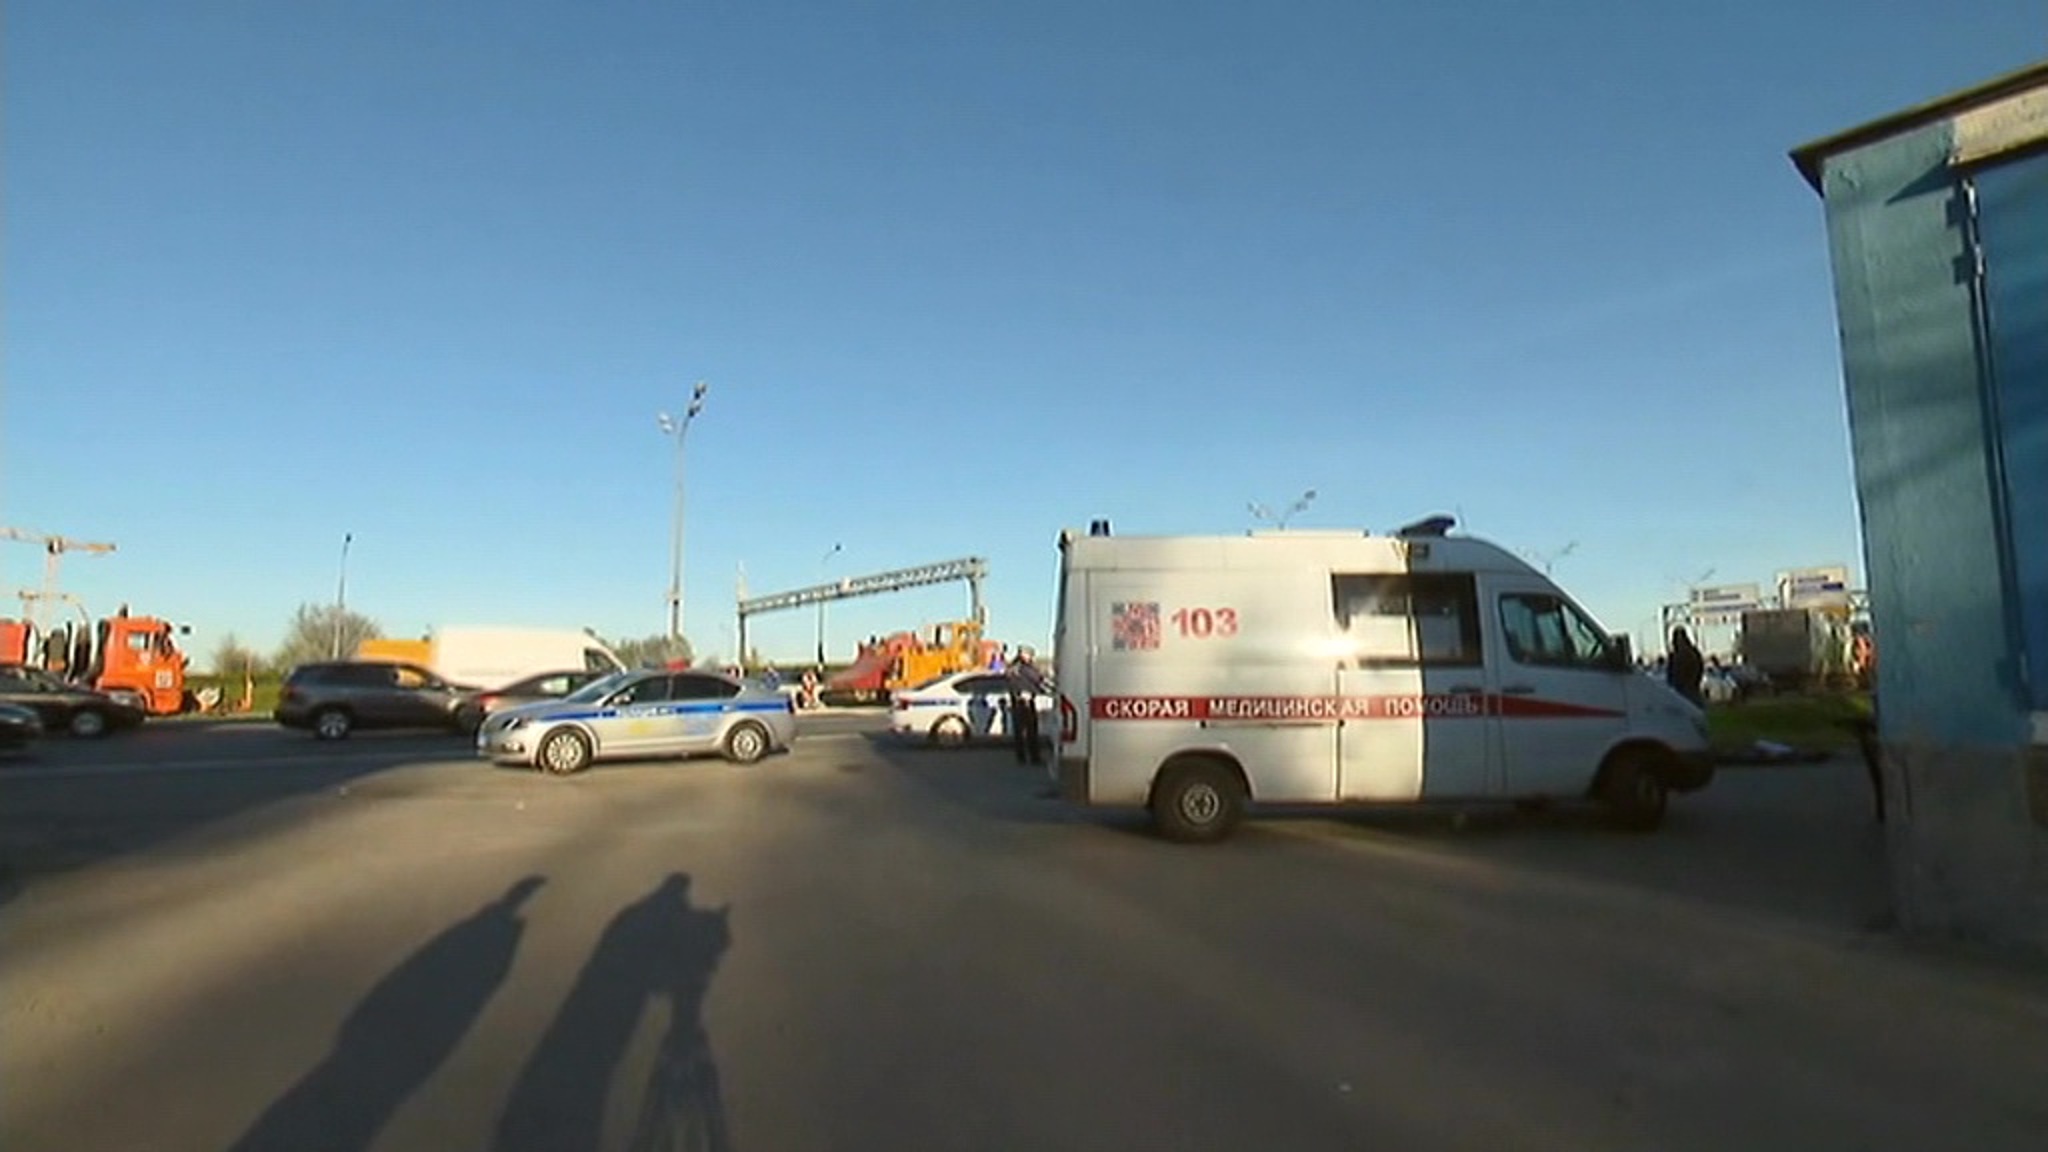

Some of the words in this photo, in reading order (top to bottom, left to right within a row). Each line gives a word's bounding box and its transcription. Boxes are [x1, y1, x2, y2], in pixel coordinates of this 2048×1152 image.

[1170, 606, 1238, 641] 103
[1104, 698, 1190, 718] СКОРАЯ
[1208, 698, 1370, 718] МЕДИЦИНСКАЯ
[1384, 697, 1479, 717] ПОМОЩЬ
